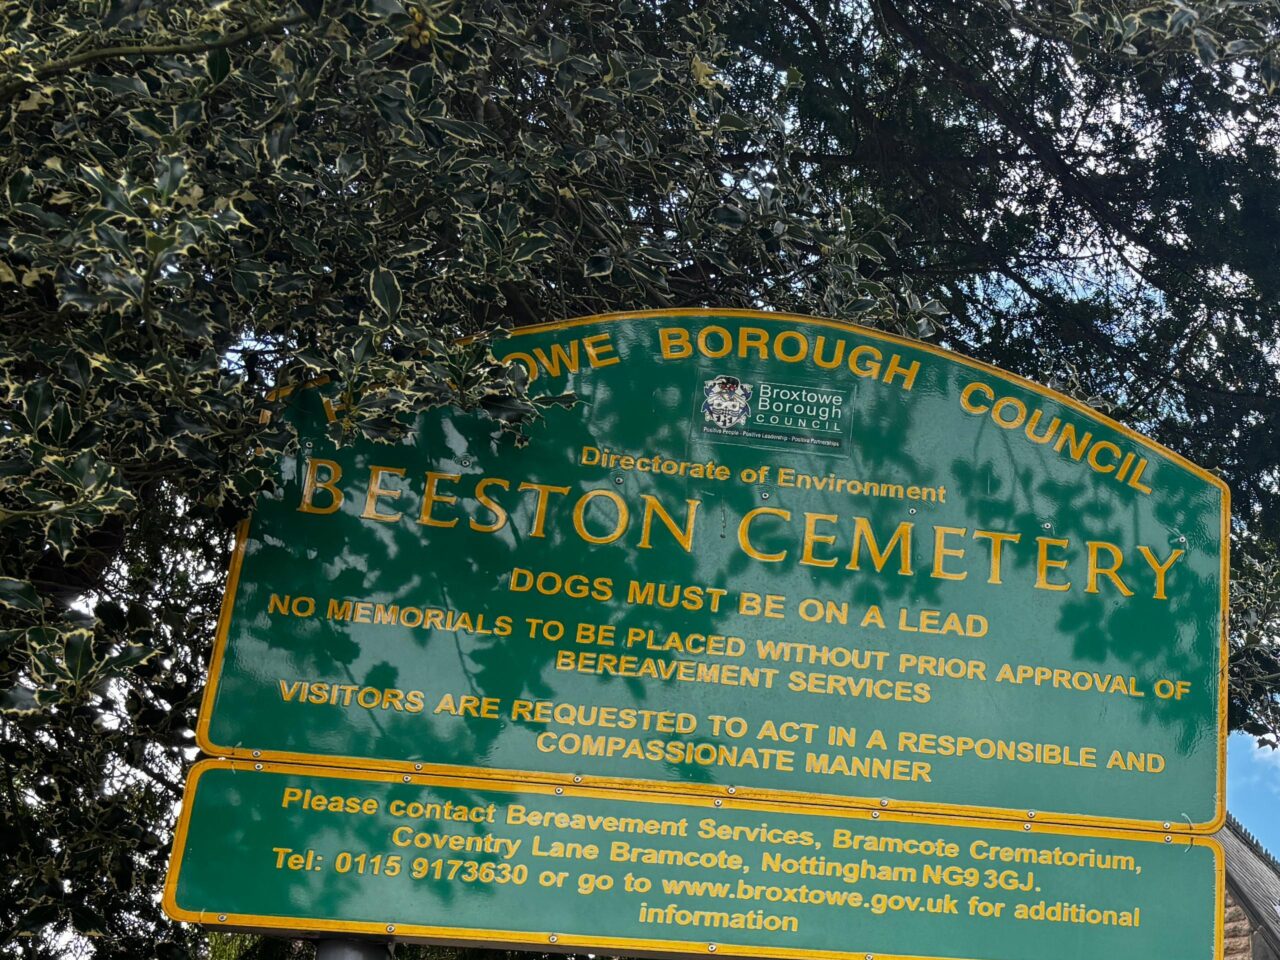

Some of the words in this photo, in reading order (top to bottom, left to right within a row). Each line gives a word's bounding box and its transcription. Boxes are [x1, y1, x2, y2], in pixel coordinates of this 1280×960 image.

[658, 325, 920, 391] BOROUGH
[960, 381, 1153, 494] COUNCIL
[756, 414, 840, 430] COUNCIL
[758, 397, 841, 420] Borough
[760, 385, 842, 405] Broxtowe
[581, 446, 730, 481] Directorate
[741, 466, 766, 483] of
[778, 469, 946, 503] Environment
[296, 458, 701, 552] BEESTON
[737, 506, 1184, 600] CEMETERY
[510, 567, 613, 600] DOGS
[627, 580, 727, 613] MUST
[739, 592, 785, 618] BE
[798, 599, 848, 624] ON
[861, 605, 885, 628] A
[899, 608, 988, 637] LEAD
[267, 593, 315, 618] NO
[326, 599, 512, 636] MEMORIALS
[525, 618, 564, 642] TO
[576, 624, 615, 646] BE
[627, 628, 745, 658] PLACED
[756, 639, 888, 670] WITHOUT
[899, 653, 986, 682] PRIOR
[996, 664, 1144, 696] APPROVAL
[1153, 678, 1190, 700] OF
[555, 650, 779, 689] BEREAVEMENT
[788, 672, 931, 703] SERVICES
[279, 680, 424, 714] VISITORS
[434, 694, 500, 720] ARE
[512, 700, 696, 736] REQUESTED
[707, 715, 748, 739] TO
[756, 720, 818, 744] ACT
[828, 725, 855, 747] IN
[867, 729, 888, 750] A
[899, 731, 1096, 768] RESPONSIBLE
[1107, 751, 1165, 773] AND
[536, 731, 794, 772] COMPASSIONATE
[805, 753, 931, 783] MANNER
[281, 788, 378, 814] Please
[390, 799, 496, 824] contact
[506, 804, 686, 836] Bereavement
[697, 819, 821, 849] Services,
[833, 829, 959, 857] Bramcote
[970, 841, 1141, 874] Crematorium,
[392, 827, 521, 859] Coventry
[532, 836, 599, 860] Lane
[609, 842, 749, 873] Bramcote,
[762, 856, 917, 888] Nottingham
[922, 866, 979, 888] NG9
[984, 869, 1041, 892] 3GJ.
[272, 847, 322, 872] Tel:
[335, 851, 401, 876] 0115
[412, 858, 528, 884] 9173630
[539, 870, 565, 887] or
[578, 872, 613, 894] go
[624, 872, 651, 893] to
[662, 877, 958, 915] www.broxtowe.gov.uk
[969, 900, 1005, 918] for
[1014, 903, 1139, 927] additional
[639, 903, 797, 931] information
